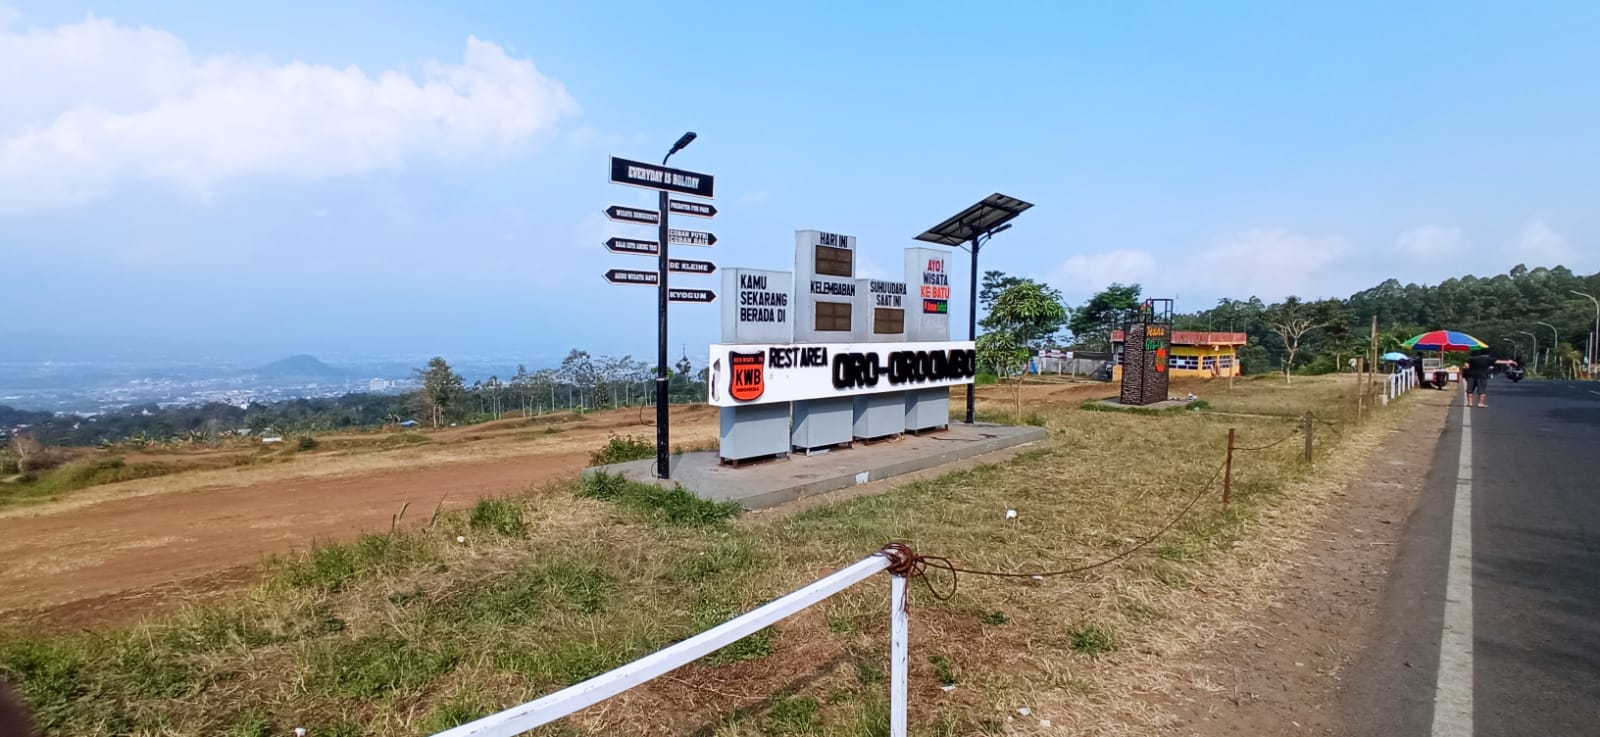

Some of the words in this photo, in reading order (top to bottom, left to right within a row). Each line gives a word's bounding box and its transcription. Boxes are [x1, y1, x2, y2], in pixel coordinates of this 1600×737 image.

[628, 166, 663, 182] EVERYDAY
[664, 172, 672, 184] IS
[672, 173, 700, 189] HOLIDAY
[669, 230, 689, 238] COBAN
[690, 231, 709, 239] PUTRI
[670, 236, 692, 245] COBAN
[820, 231, 838, 246] HARI
[838, 234, 849, 249] INI
[669, 262, 680, 270] DE
[681, 263, 709, 271] KLEINE
[627, 273, 645, 281] WISATA
[740, 274, 767, 290] KAMU
[923, 271, 948, 286] WISATA
[810, 280, 855, 296] KELEMBABAN
[920, 285, 931, 298] KE
[932, 286, 950, 299] BATU
[740, 291, 788, 307] SEKARANG
[876, 294, 894, 307] SAAT
[893, 295, 902, 308] INI
[740, 307, 775, 323] BERADA
[777, 309, 786, 323] DI
[736, 369, 761, 386] KWB
